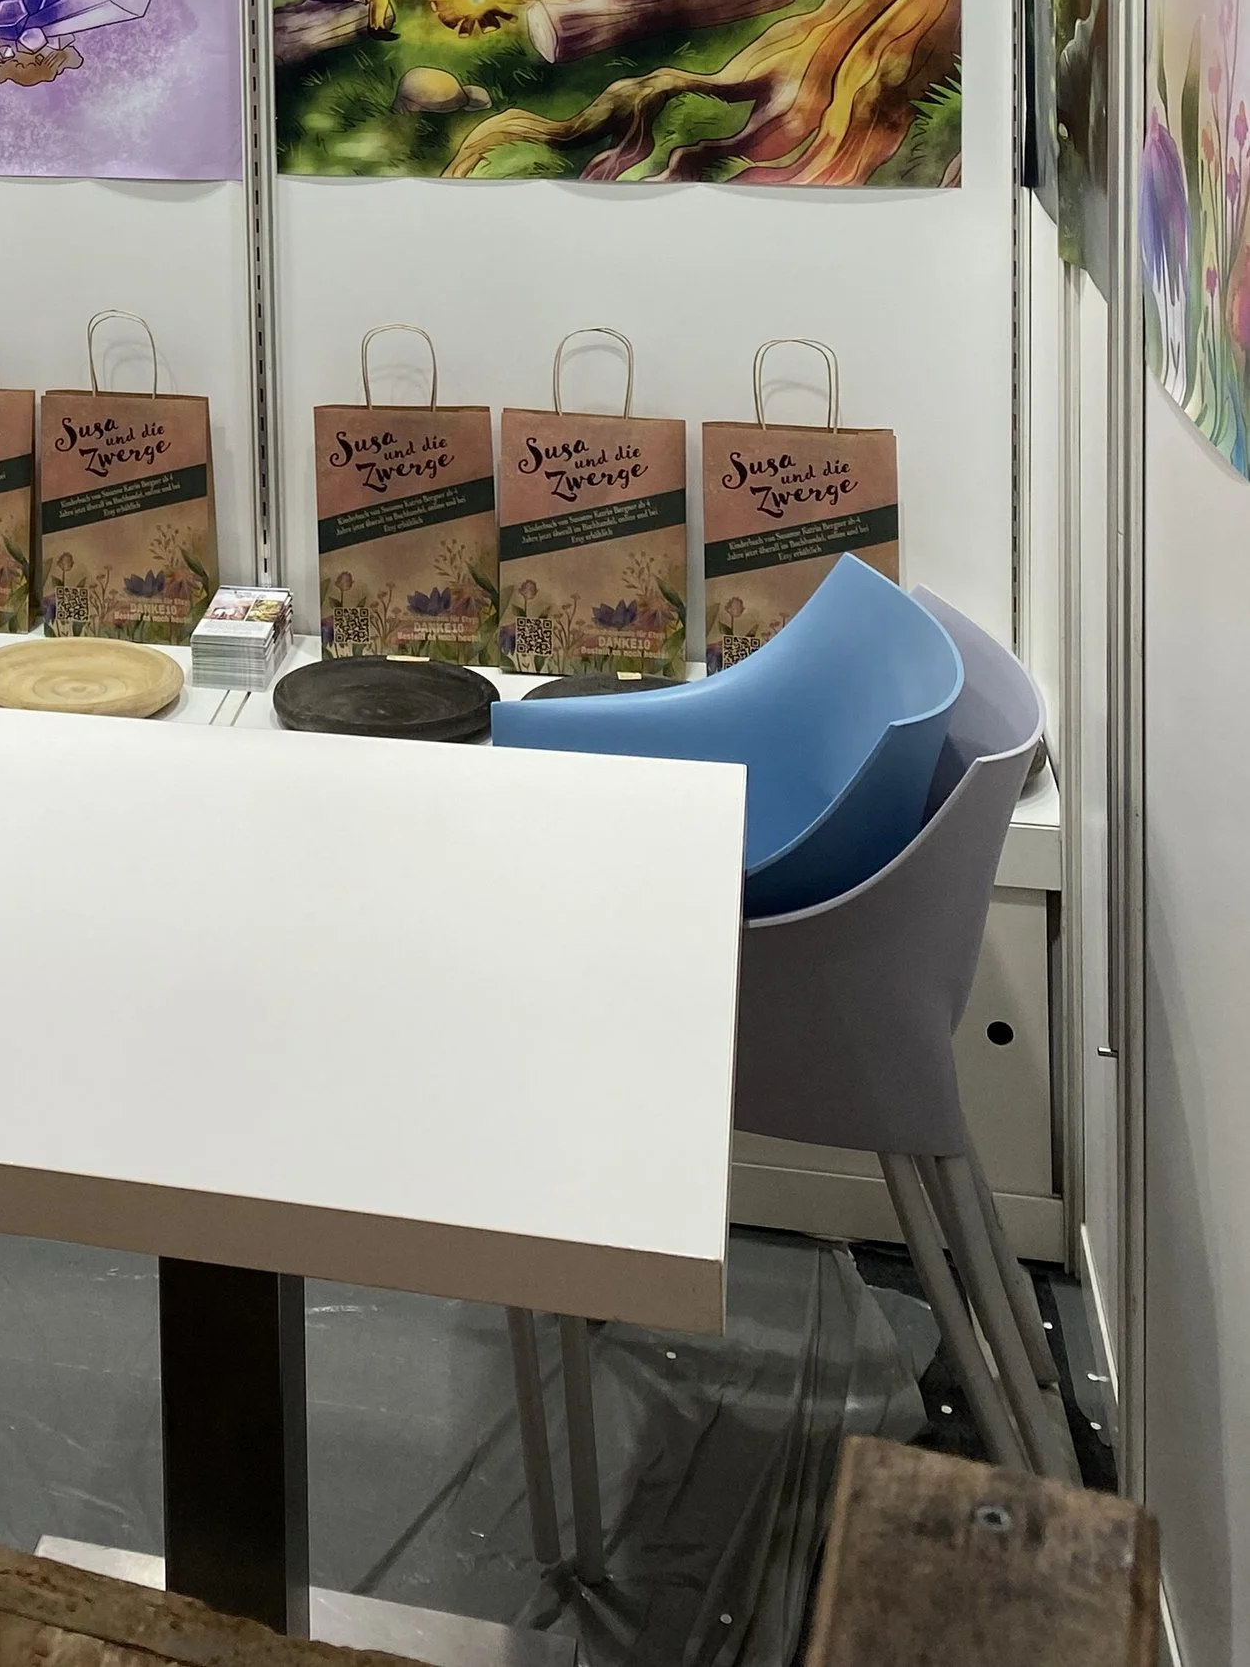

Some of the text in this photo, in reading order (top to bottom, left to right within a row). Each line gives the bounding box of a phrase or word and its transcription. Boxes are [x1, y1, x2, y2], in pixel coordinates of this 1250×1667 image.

[54, 417, 119, 452] Susa
[105, 422, 165, 446] und die
[329, 431, 397, 467] Susa
[383, 435, 447, 461] und die
[78, 440, 171, 477] Zwerge
[354, 453, 454, 492] Zwerge
[517, 437, 589, 474] Susa
[574, 444, 641, 469] und die
[721, 452, 796, 489] Susa
[780, 459, 850, 484] und die
[544, 463, 648, 502] Zwerge
[749, 479, 858, 518] Zwerge
[130, 603, 177, 614] DANKE10
[414, 622, 464, 633] DANKE10
[598, 636, 650, 650] DANKE10
